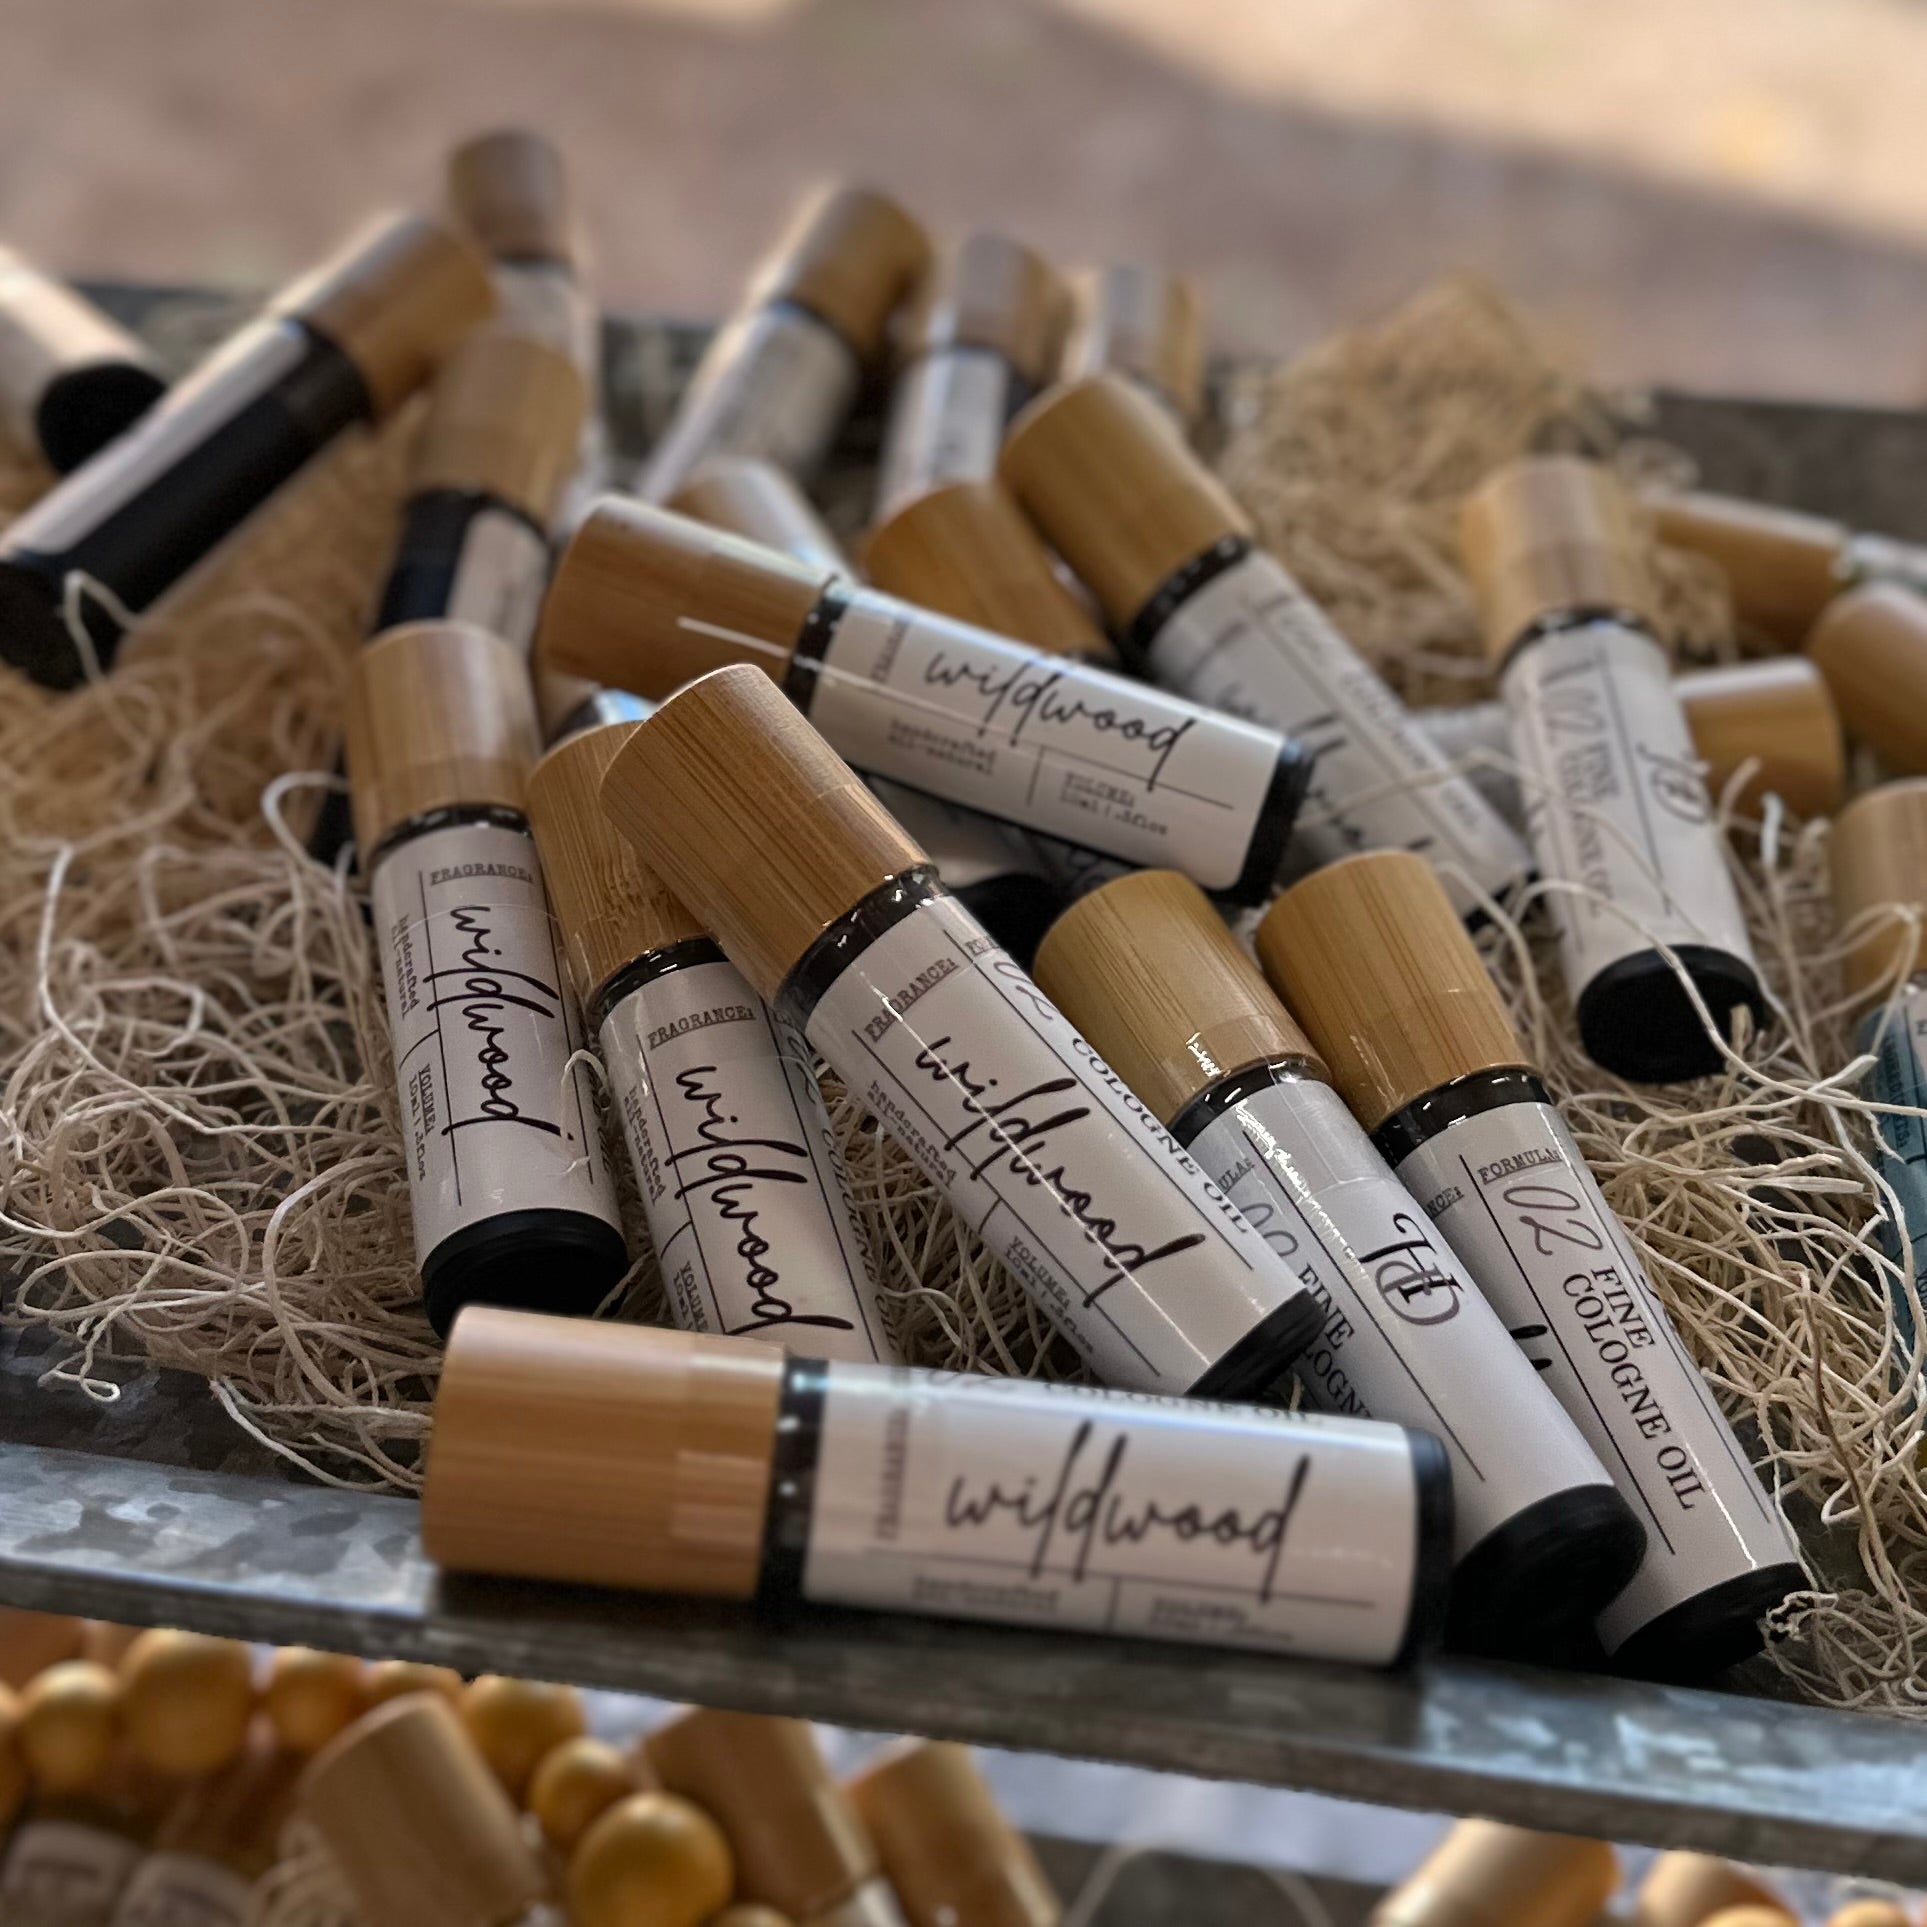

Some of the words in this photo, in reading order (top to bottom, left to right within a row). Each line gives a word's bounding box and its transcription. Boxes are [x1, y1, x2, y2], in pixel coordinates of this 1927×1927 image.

[924, 652, 1197, 793] wildwood
[423, 905, 574, 1141] wildwood
[647, 1005, 757, 1051] FRAGRANCE:
[665, 1065, 855, 1335] wildwood
[915, 1036, 1206, 1307] wildwood
[1072, 1037, 1200, 1176] COLOGNE
[1203, 1181, 1248, 1233] OIL
[1477, 1147, 1563, 1185] FORMULA:
[679, 1260, 709, 1333] VOLUME
[1503, 1185, 1603, 1256] 02
[1591, 1265, 1656, 1349] FINE
[1562, 1273, 1672, 1440] COLOGNE
[1656, 1445, 1706, 1511] OIL
[945, 1418, 1310, 1608] wildwood
